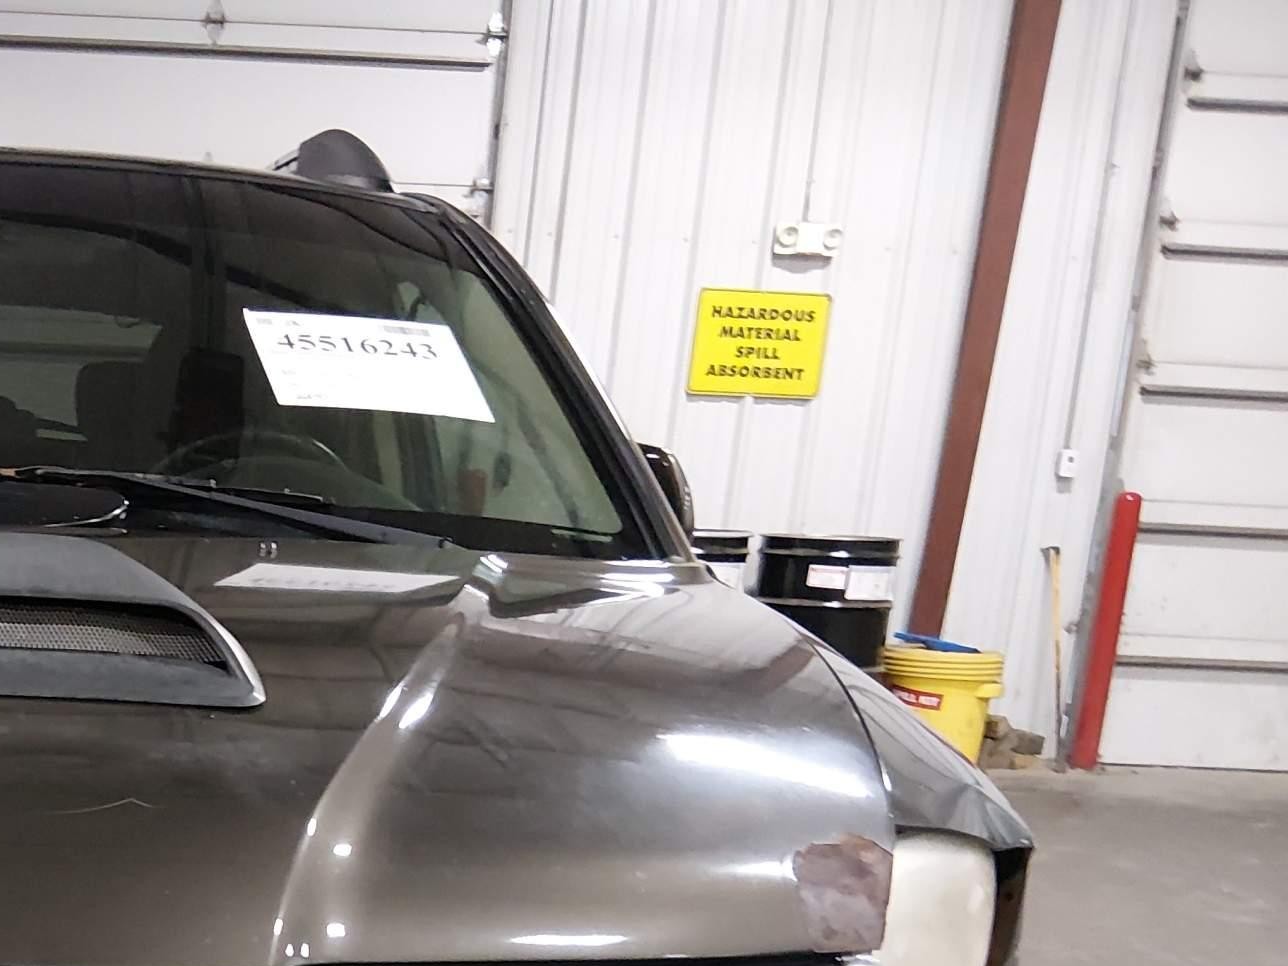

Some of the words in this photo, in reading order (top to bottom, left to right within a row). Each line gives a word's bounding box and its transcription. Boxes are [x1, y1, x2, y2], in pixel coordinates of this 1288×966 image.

[711, 305, 816, 322] HAZARDOUS
[719, 325, 801, 341] MATERIAL
[277, 333, 439, 360] 45516243
[735, 346, 779, 359] SPILL
[706, 364, 804, 380] ABSORBENT
